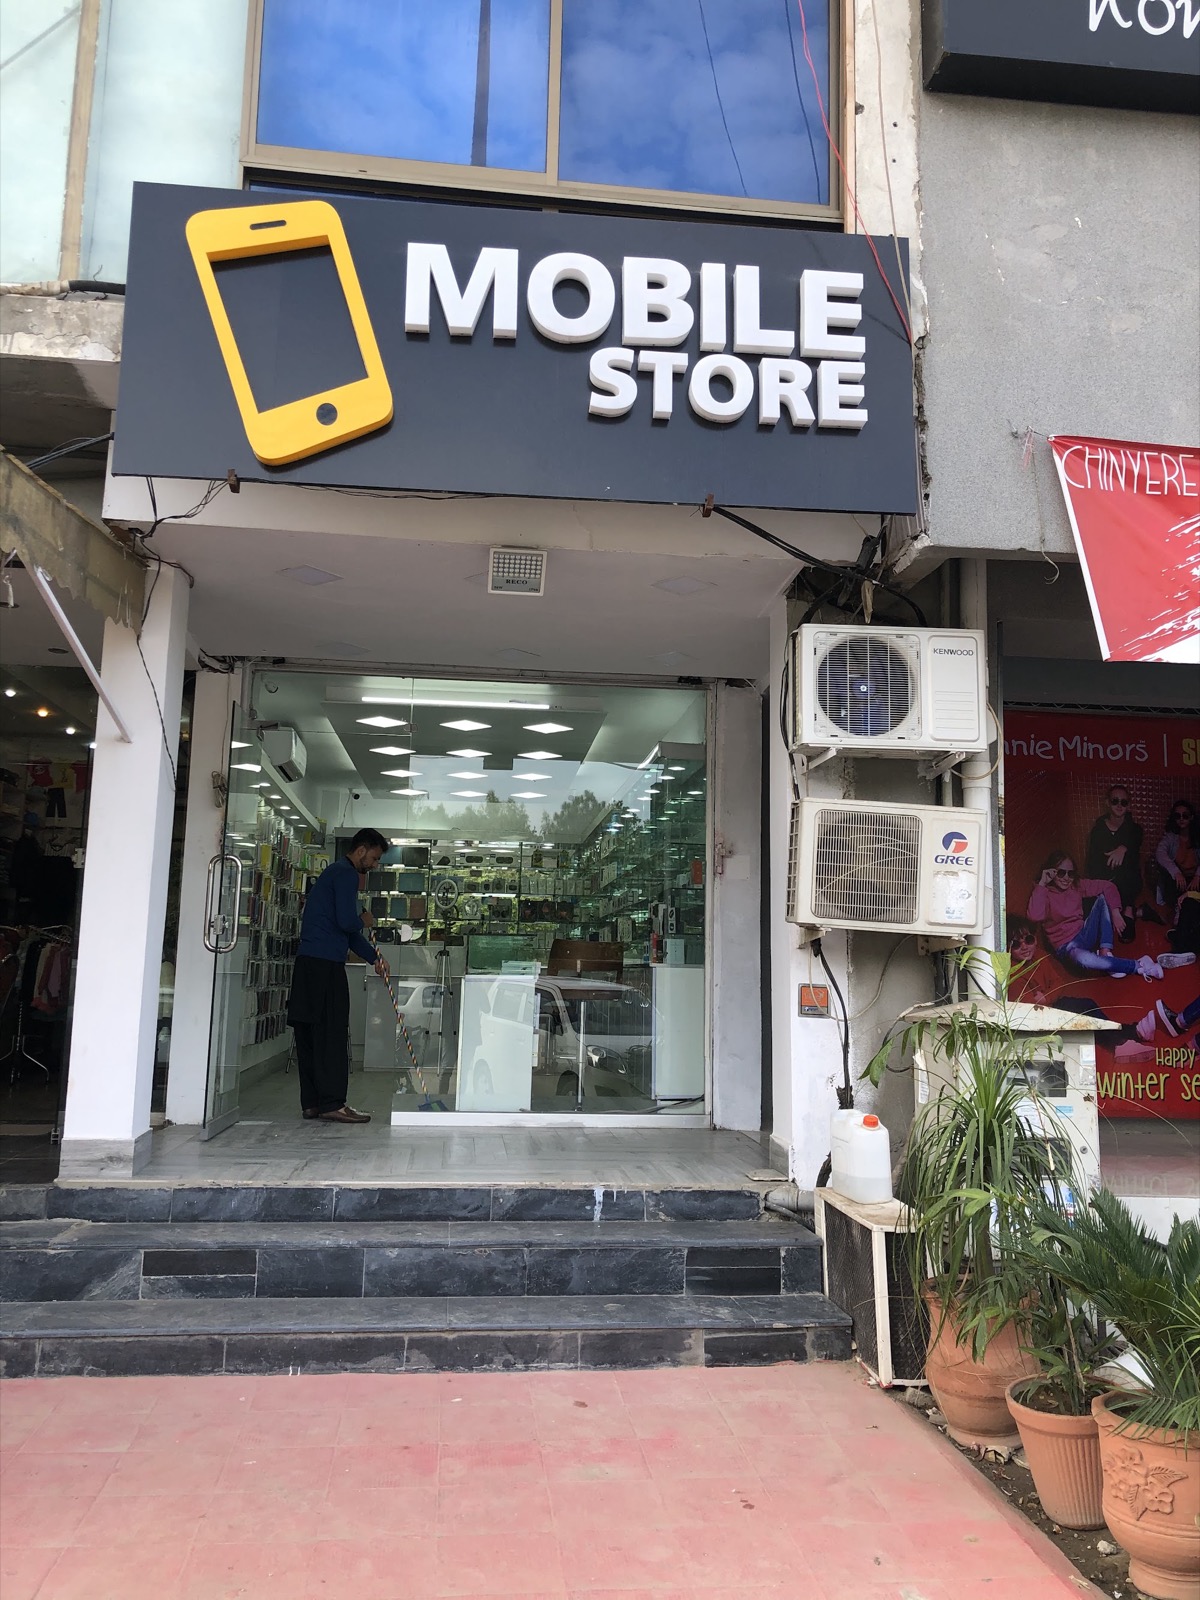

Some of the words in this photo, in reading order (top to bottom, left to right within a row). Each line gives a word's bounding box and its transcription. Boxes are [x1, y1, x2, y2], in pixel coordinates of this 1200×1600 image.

[404, 242, 866, 360] MOBILE
[588, 346, 868, 430] STORE
[1061, 445, 1199, 496] CHINYERE
[933, 648, 974, 656] KENWOOD
[1059, 735, 1148, 762] Minors
[934, 854, 974, 867] GREE
